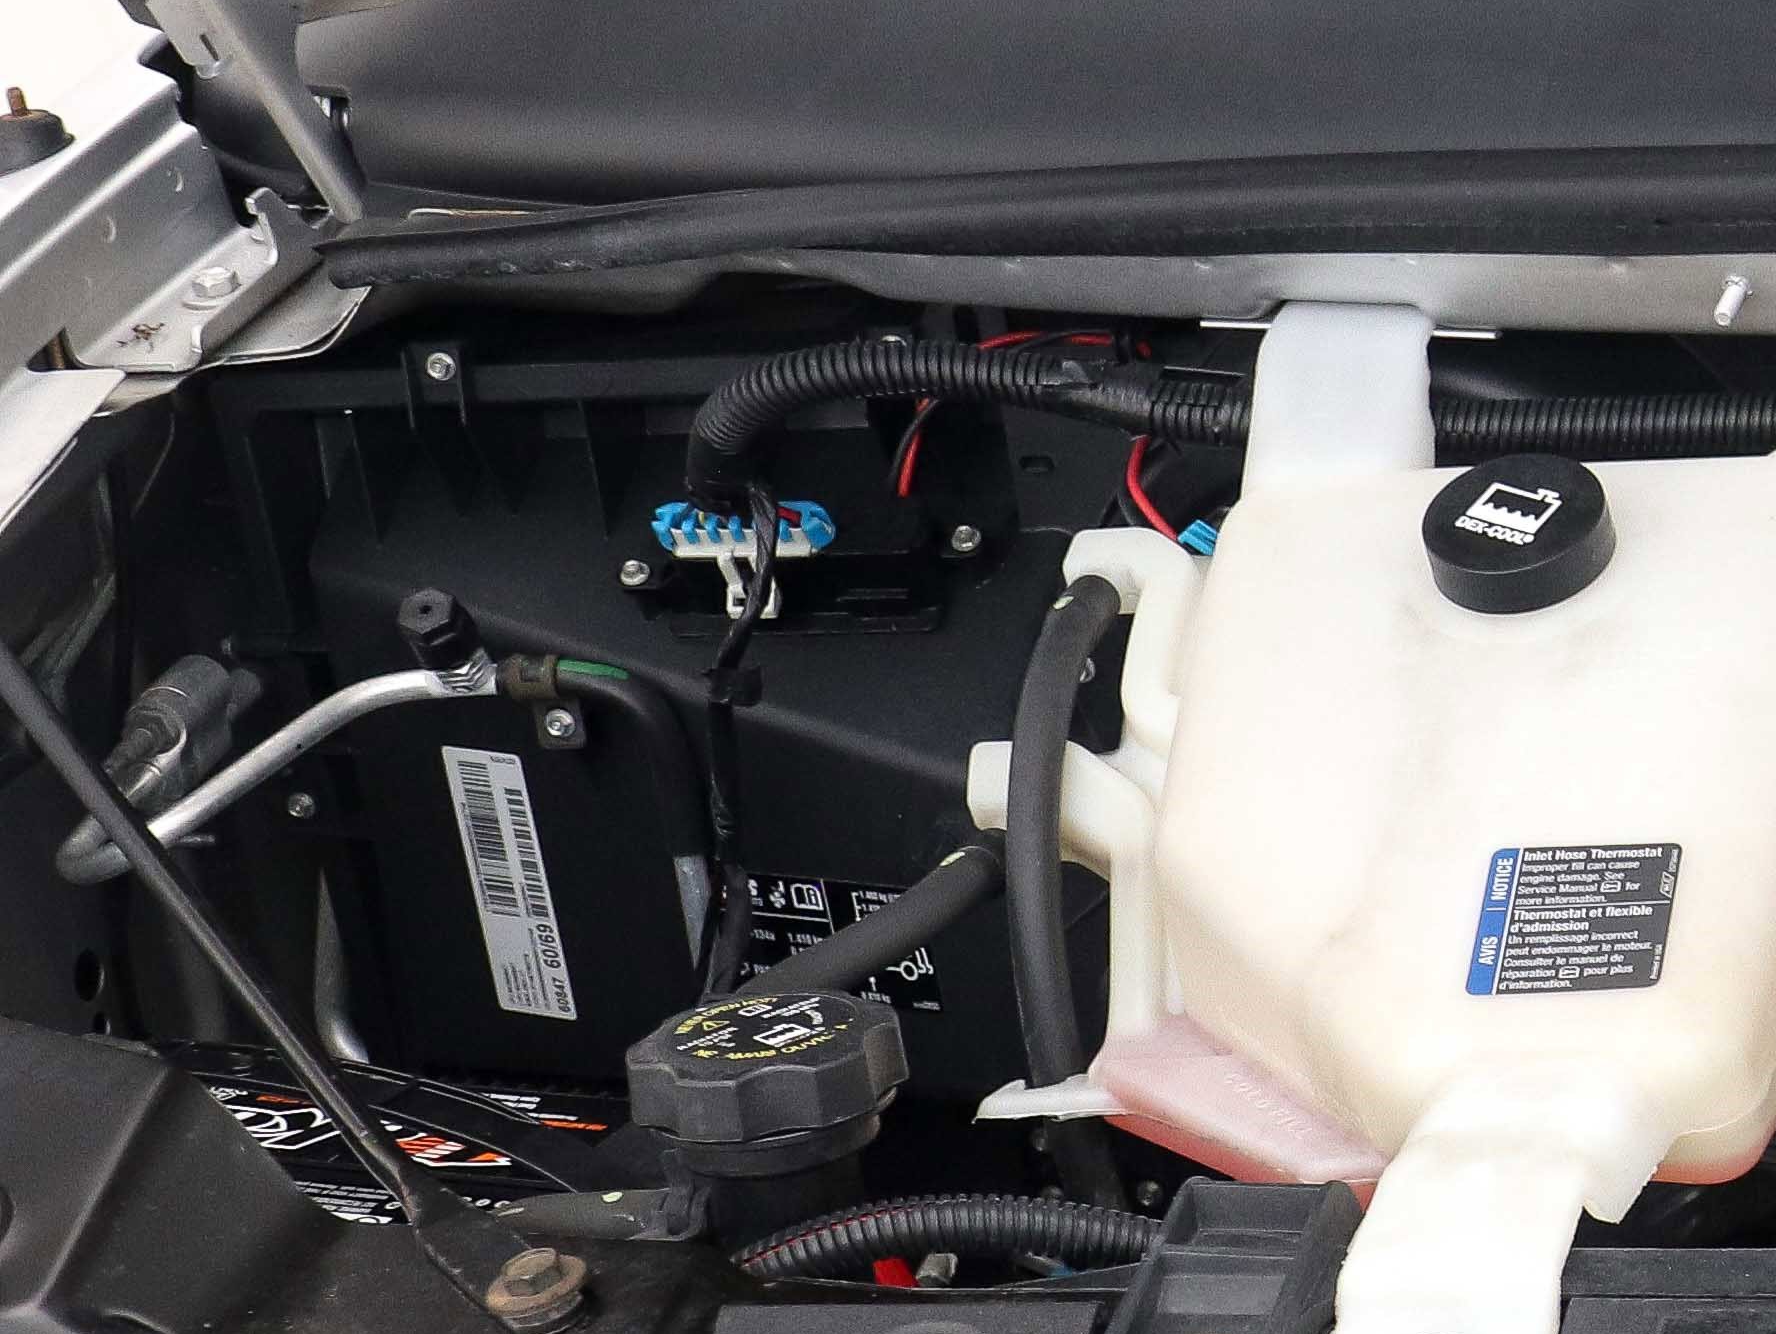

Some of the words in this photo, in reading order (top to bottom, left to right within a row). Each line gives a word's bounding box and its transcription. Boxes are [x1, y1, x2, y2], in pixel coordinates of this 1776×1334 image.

[1523, 849, 1553, 862] Inlet
[1554, 848, 1588, 861] Hose
[1590, 846, 1663, 860] Thermostat
[1490, 857, 1514, 901] NOTICE
[1512, 908, 1588, 922] Thermostat
[1588, 907, 1603, 919] et
[1605, 904, 1653, 917] flexible
[536, 923, 562, 969] 60/69
[1478, 935, 1499, 966] AVIS
